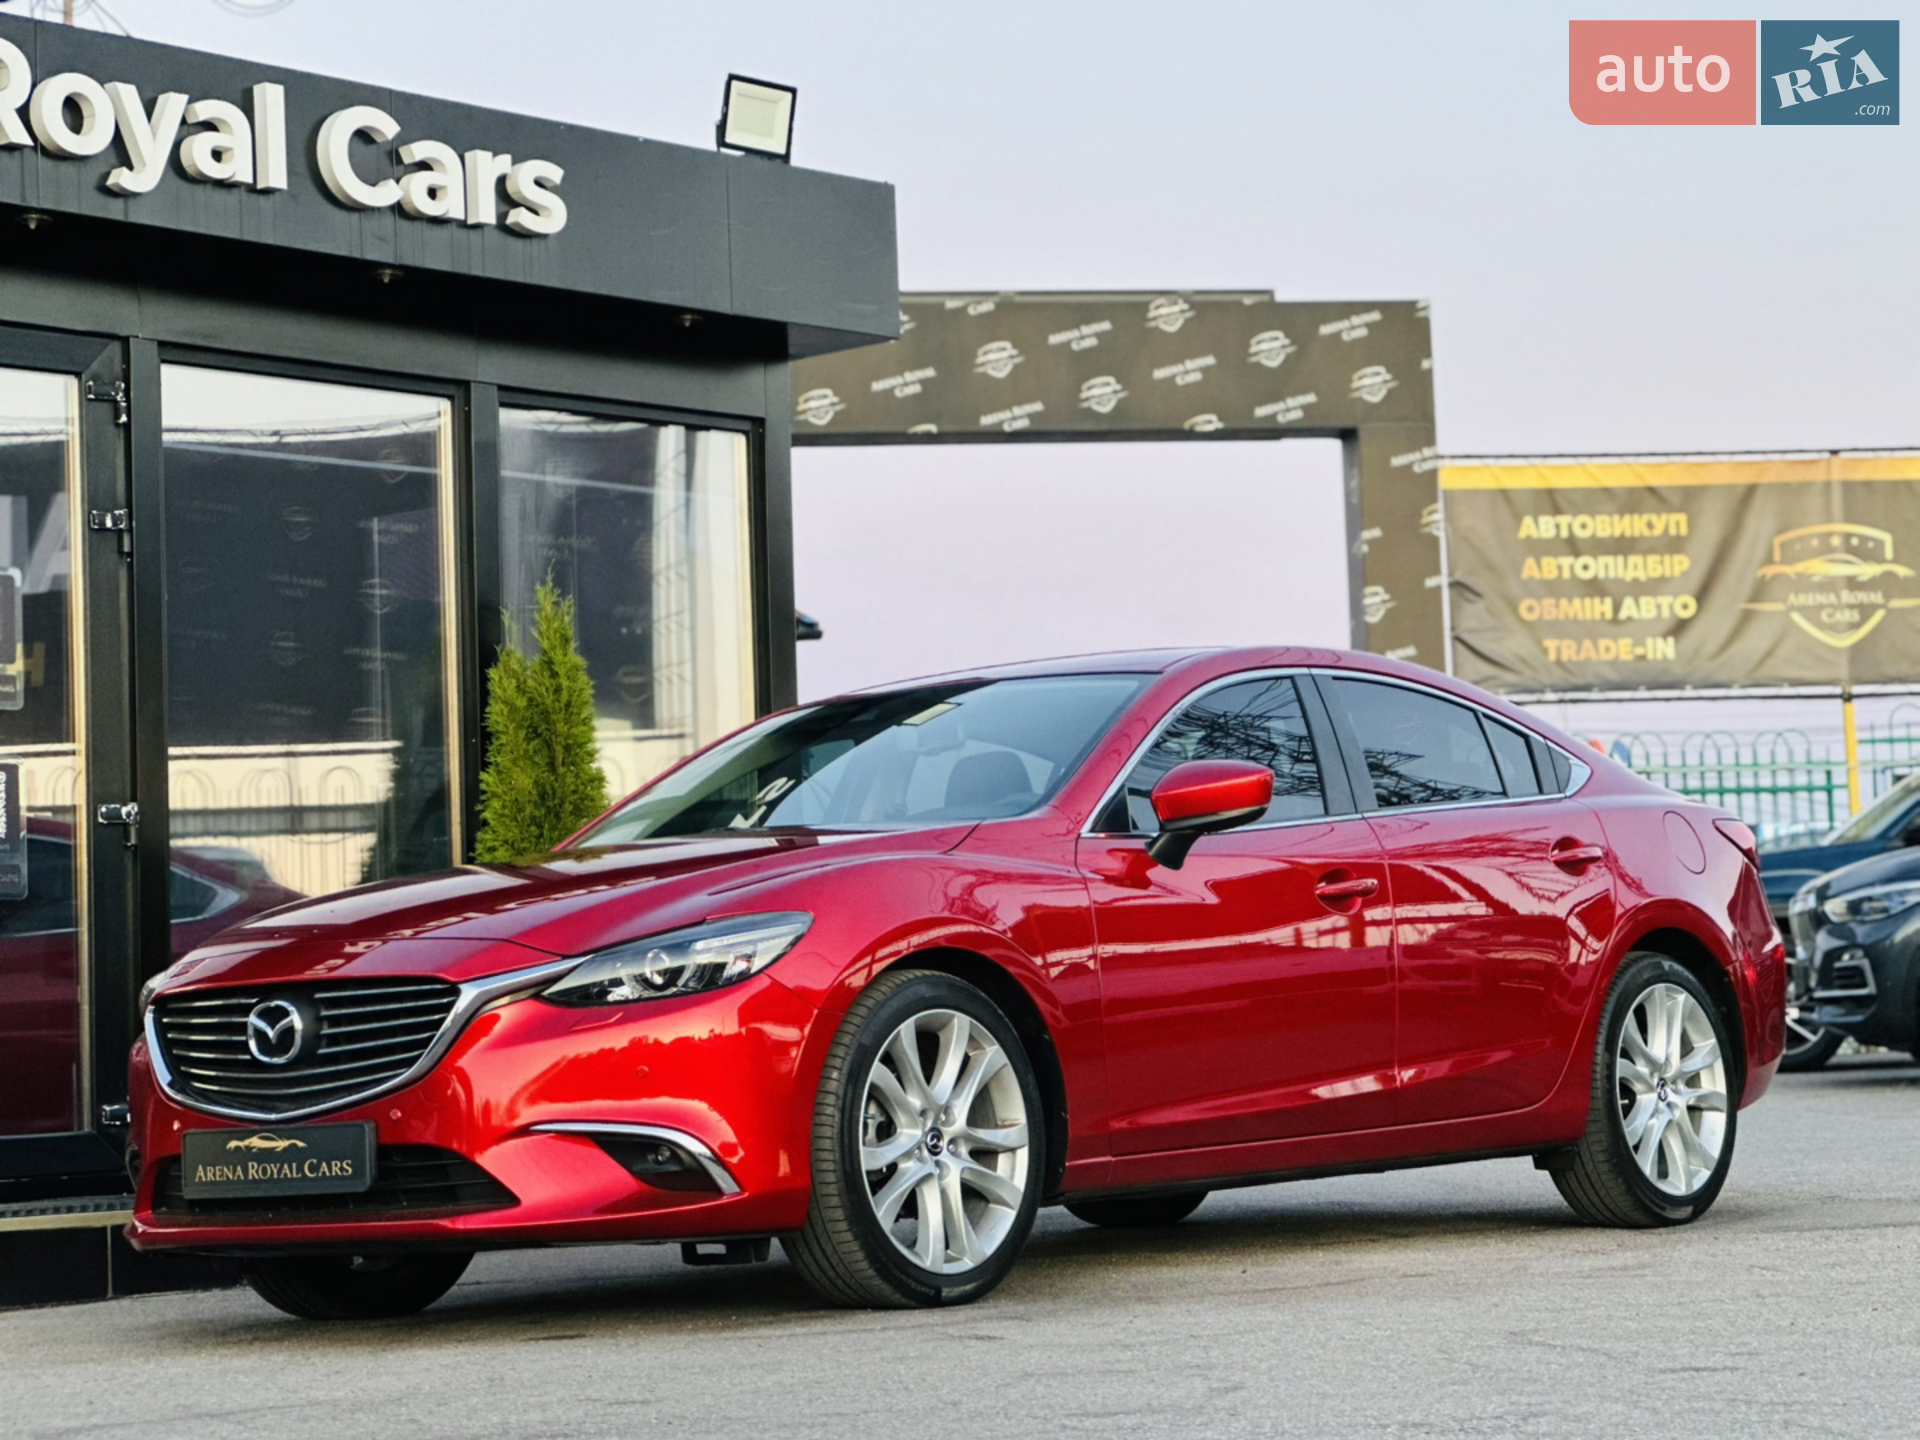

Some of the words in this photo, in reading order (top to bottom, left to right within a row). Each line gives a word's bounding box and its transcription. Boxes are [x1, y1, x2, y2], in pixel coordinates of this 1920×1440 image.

[315, 105, 568, 235] Cars
[1517, 512, 1689, 539] АВТОВИКУП
[1520, 553, 1691, 582] АВТОПІДБІР
[1518, 596, 1613, 621] ОБМІН
[1618, 594, 1698, 620] АВТО
[1542, 635, 1676, 662] TRADE-IN
[195, 1164, 244, 1182] ARENA
[247, 1161, 302, 1180] ROYAL
[304, 1158, 353, 1177] CARS
